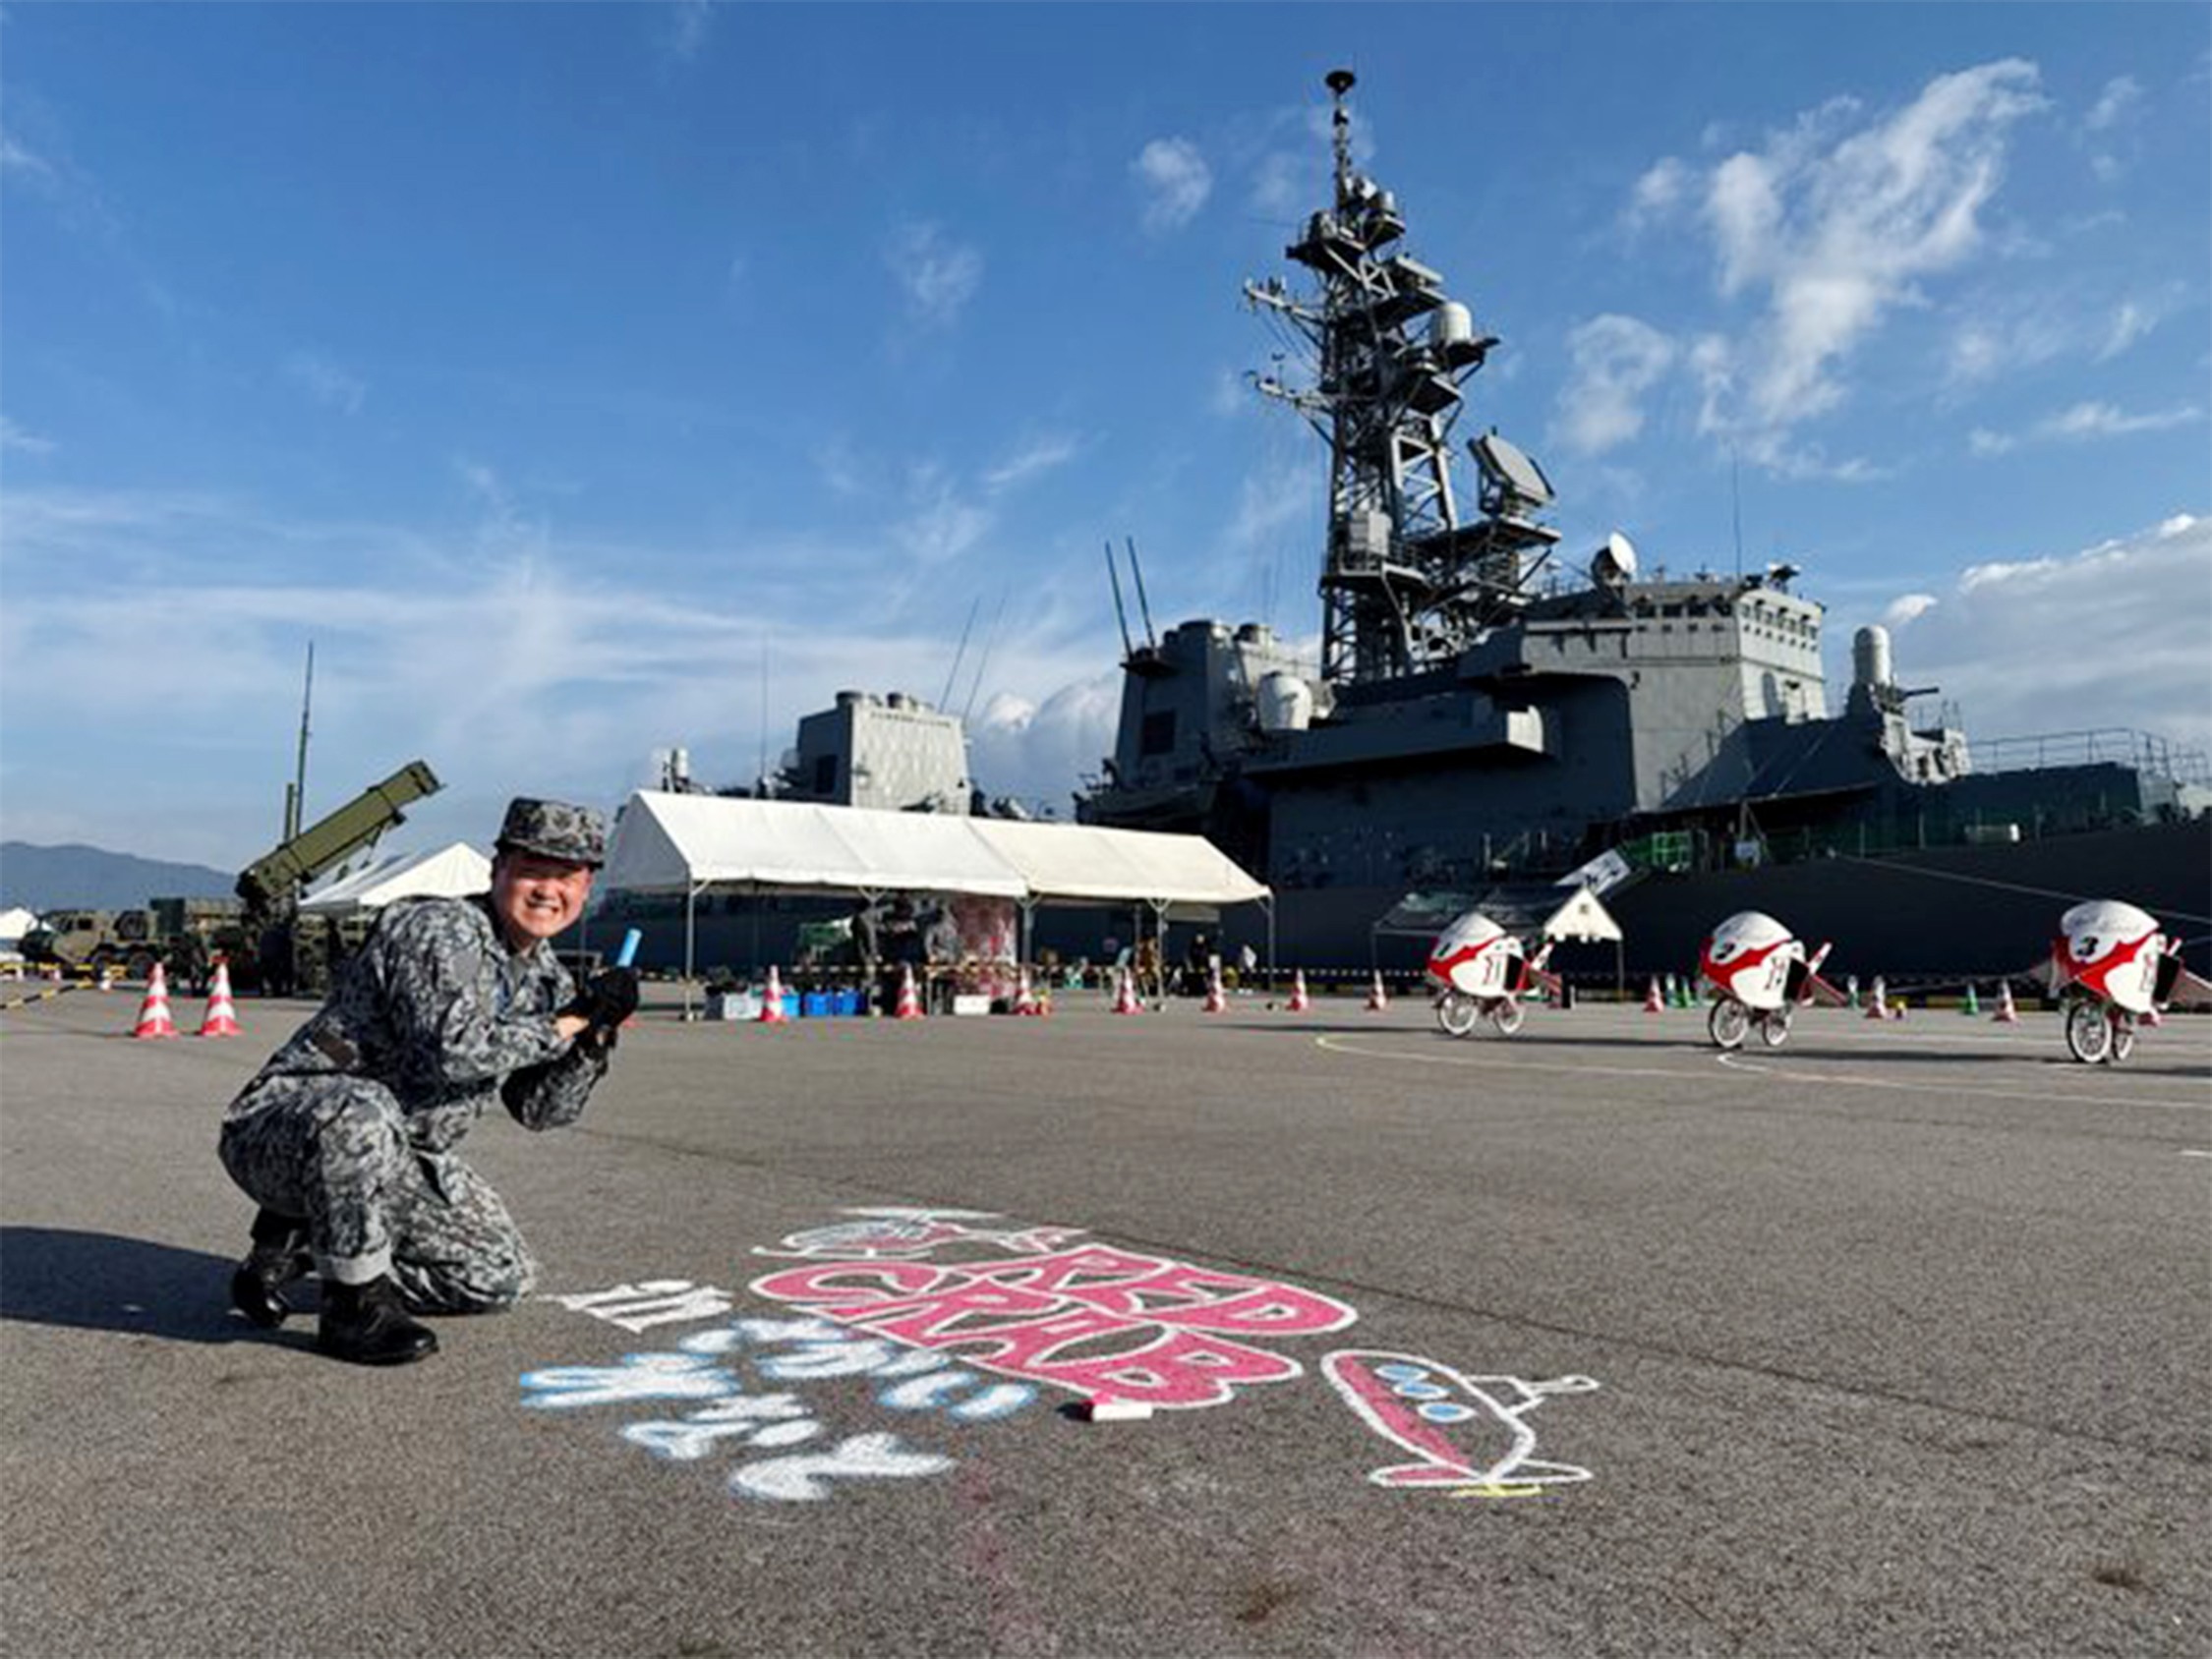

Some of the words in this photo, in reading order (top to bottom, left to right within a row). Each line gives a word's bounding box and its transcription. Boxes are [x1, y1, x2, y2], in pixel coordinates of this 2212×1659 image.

[2075, 936, 2100, 957] 3
[541, 1280, 735, 1334] in
[938, 1242, 1359, 1335] RED
[750, 1261, 1305, 1408] CRAB
